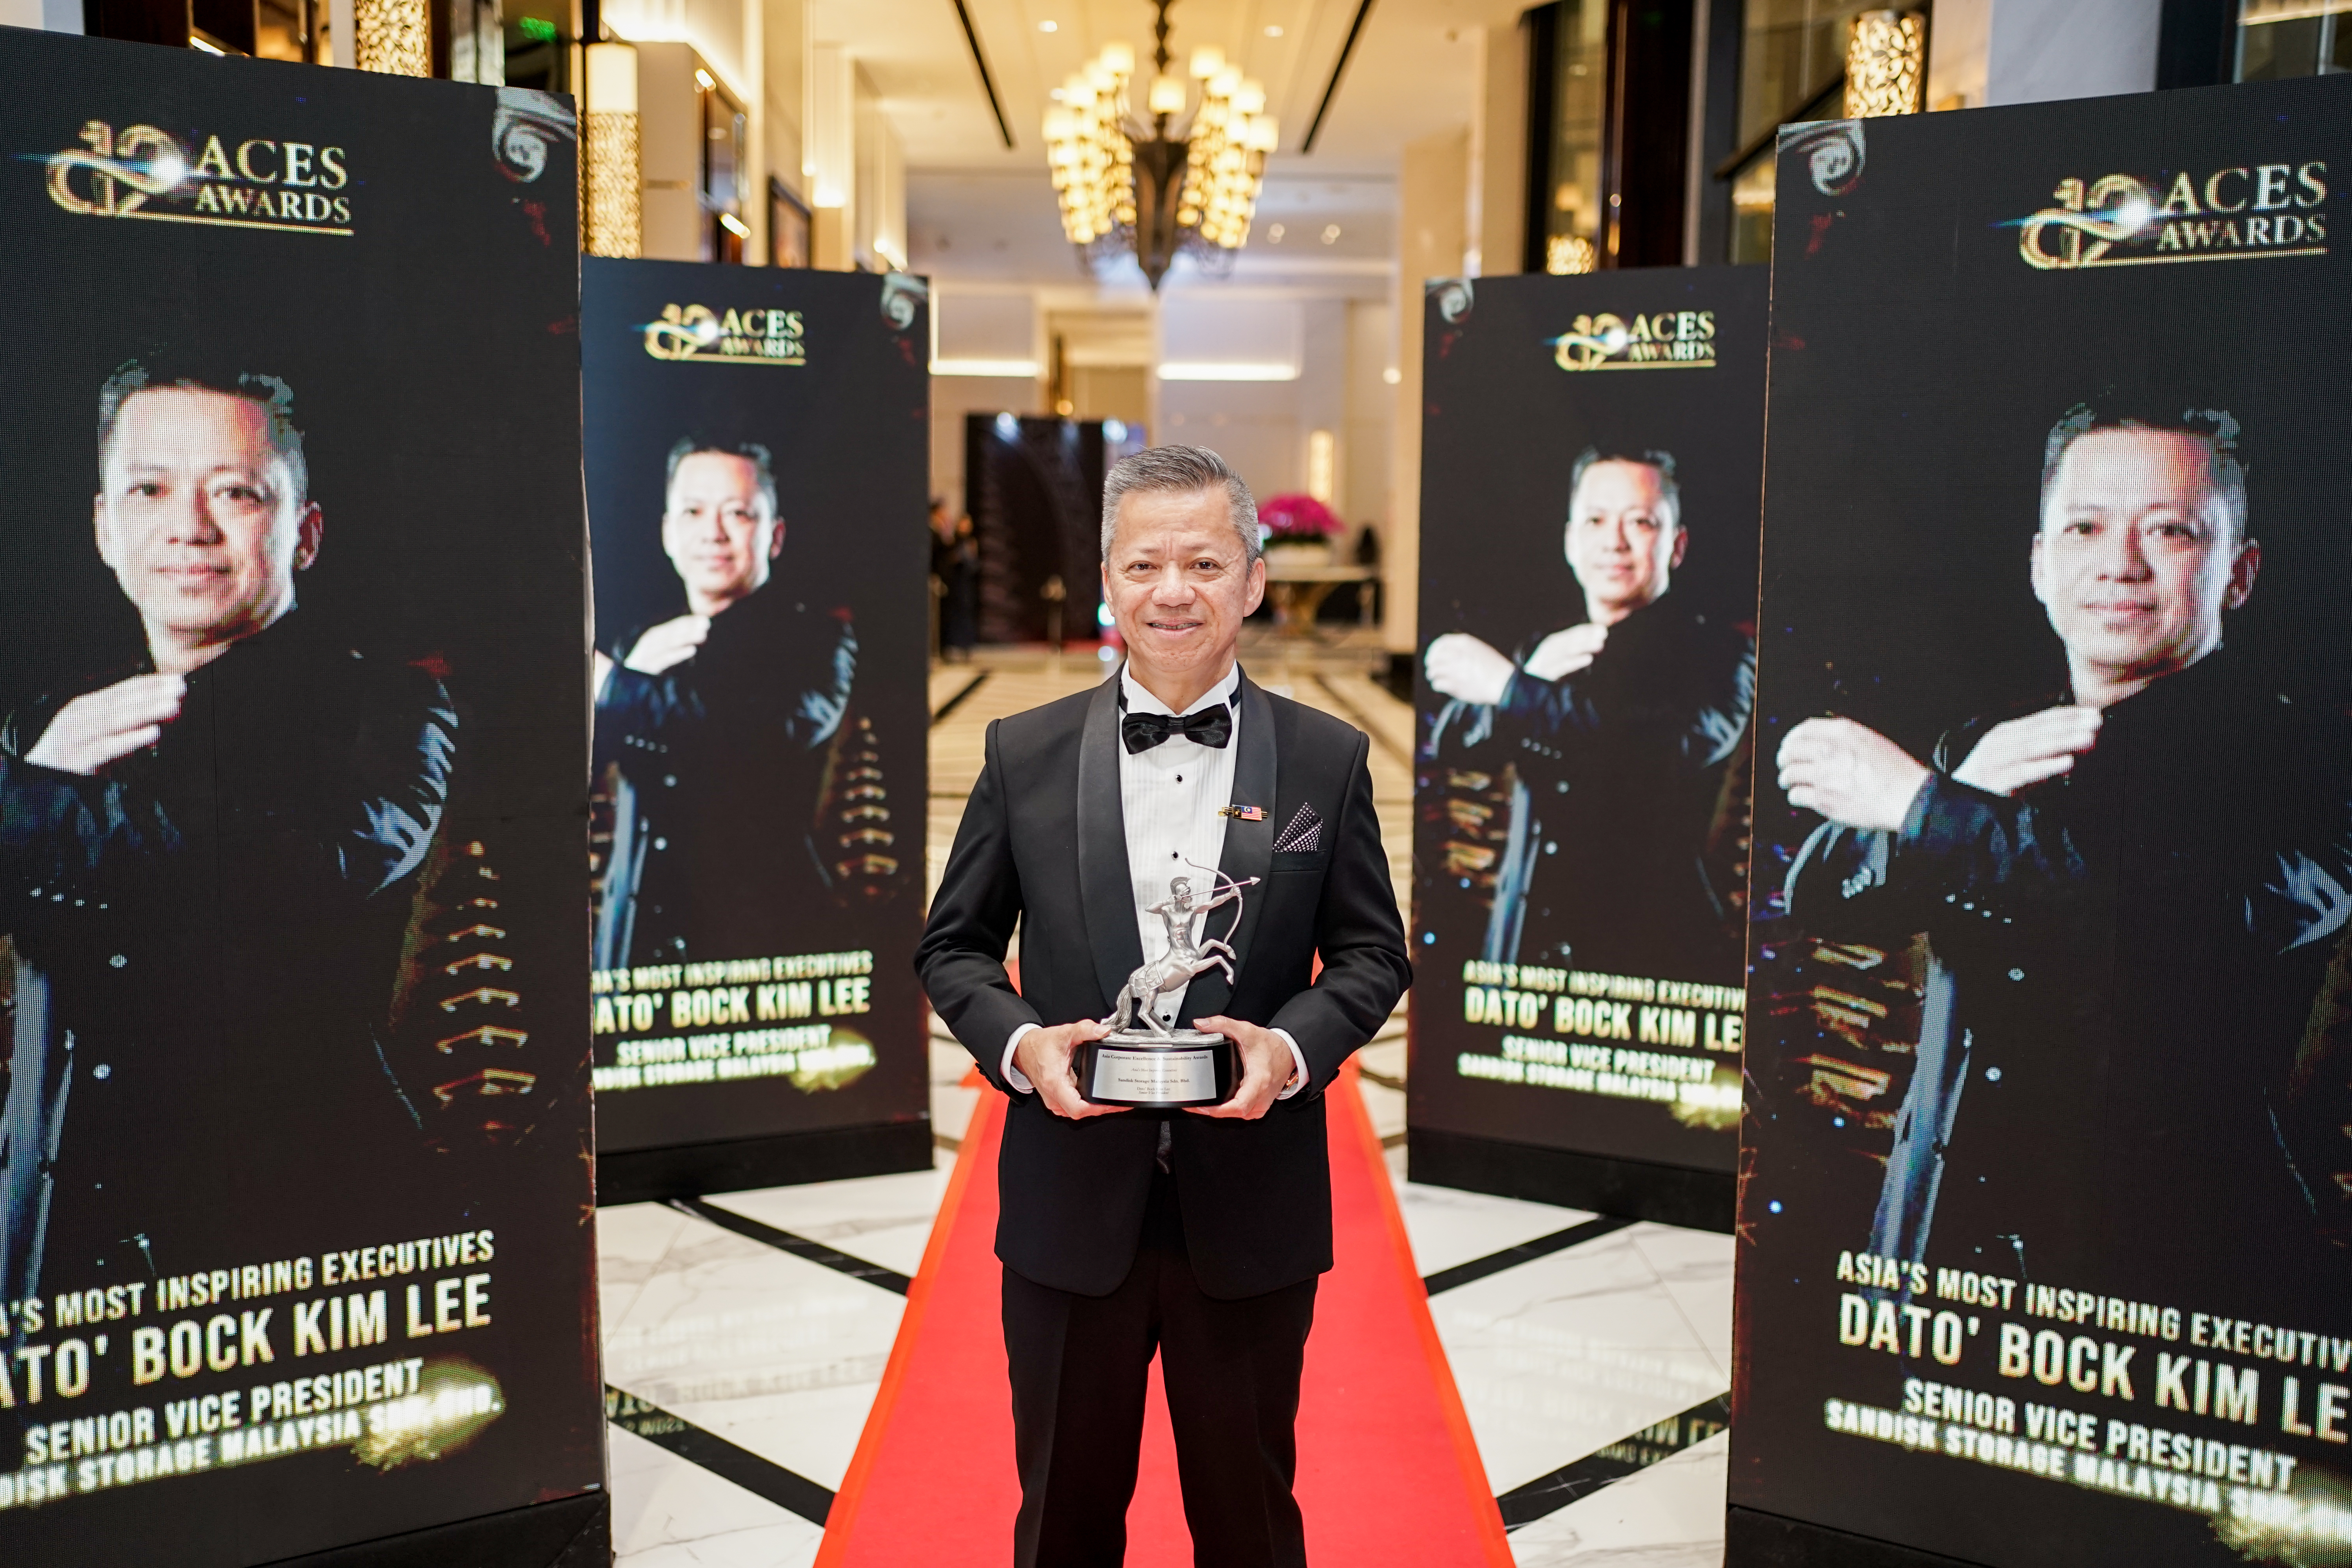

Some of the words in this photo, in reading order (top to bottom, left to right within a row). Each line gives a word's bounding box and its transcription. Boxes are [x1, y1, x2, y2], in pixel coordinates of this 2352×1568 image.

[194, 134, 348, 190] ACES
[2159, 161, 2327, 216] ACES
[195, 183, 353, 223] AWARDS
[2156, 214, 2327, 251] AWARDS
[720, 307, 804, 339] ACES
[1630, 311, 1715, 342] ACES
[633, 965, 682, 989] MOST
[685, 958, 771, 985] INSPIRING
[773, 951, 872, 980] EXECUTIVES
[1464, 960, 1518, 987] ASIA'S
[1520, 966, 1567, 991] MOST
[1569, 972, 1655, 1002] INSPIRING
[671, 987, 749, 1027] BOCK
[757, 982, 811, 1020] KIM
[818, 977, 870, 1015] LEE
[1465, 987, 1548, 1028] DATO'
[1555, 996, 1632, 1040] BOCK
[1640, 1006, 1696, 1047] KIM
[1705, 1013, 1743, 1052] LE
[617, 1038, 686, 1066] SENIOR
[688, 1033, 731, 1059] VICE
[733, 1025, 832, 1055] PRESIDENT
[1501, 1036, 1568, 1067] SENIOR
[1569, 1044, 1612, 1072] VICE
[1614, 1049, 1715, 1084] PRESIDENT
[56, 1283, 145, 1326] MOST
[157, 1257, 312, 1311] INSPIRING
[323, 1230, 494, 1285] EXECUTIVES
[1837, 1251, 1928, 1294] ASIA'S
[1937, 1268, 2016, 1309] MOST
[2026, 1284, 2180, 1340] INSPIRING
[133, 1308, 274, 1384] BOCK
[294, 1290, 386, 1356] KIM
[407, 1274, 490, 1337] LEE
[1840, 1294, 1979, 1364] DATO'
[2000, 1323, 2135, 1399] BOCK
[2156, 1353, 2258, 1424] KIM
[2283, 1377, 2349, 1442] LE
[27, 1408, 154, 1464] SENIOR
[165, 1391, 240, 1437] VICE
[252, 1358, 423, 1422] PRESIDENT
[1904, 1378, 2015, 1433] SENIOR
[2025, 1403, 2097, 1450] VICE
[2107, 1420, 2296, 1490] PRESIDENT
[78, 1437, 210, 1490] STORAGE
[220, 1410, 361, 1462] MALAYSIA
[1826, 1400, 1937, 1449] SANDISK
[1944, 1425, 2066, 1478] STORAGE
[2073, 1453, 2221, 1512] MALAYSIA
